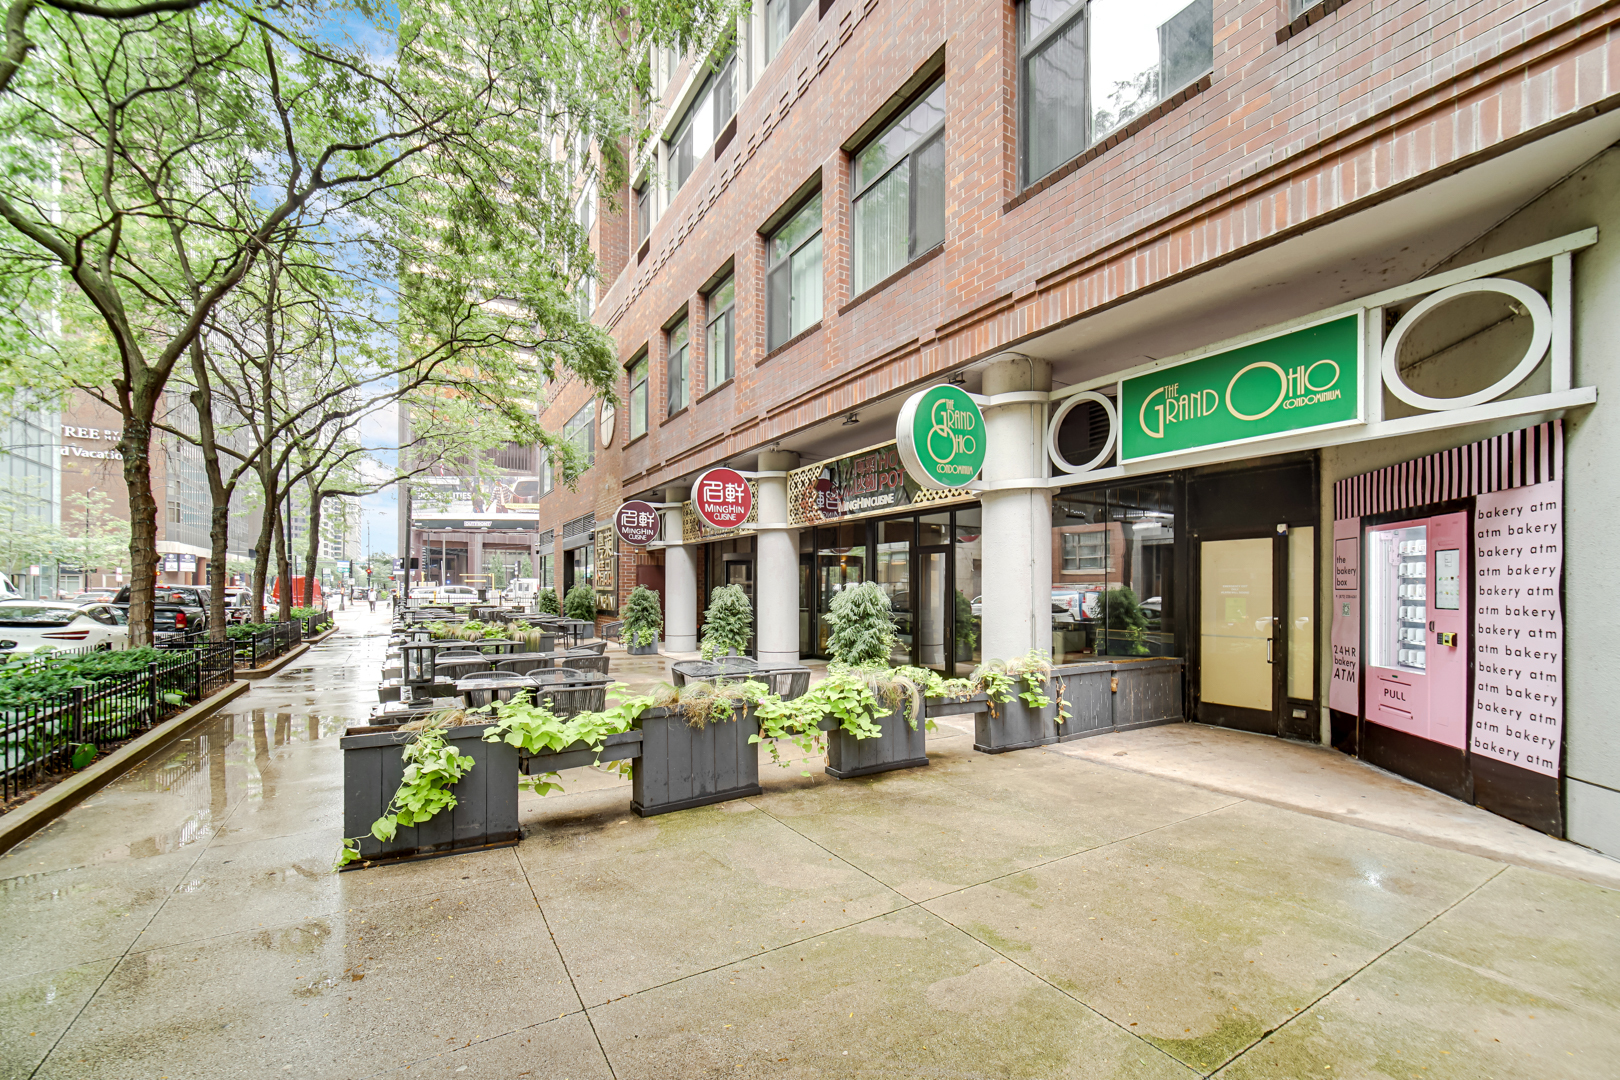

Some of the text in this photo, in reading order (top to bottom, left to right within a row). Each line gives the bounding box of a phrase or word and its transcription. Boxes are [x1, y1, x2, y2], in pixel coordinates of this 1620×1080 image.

[1139, 359, 1340, 439] GRAND OHIO
[1165, 383, 1179, 400] THE
[946, 398, 954, 410] THE
[1283, 389, 1341, 410] CONDOMINIUM
[932, 398, 975, 438] GRAND
[61, 424, 100, 439] REE
[927, 424, 976, 464] OHIO
[879, 450, 903, 471] HO
[936, 464, 974, 475] CONDOMINIUM
[880, 468, 906, 490] POT
[1478, 502, 1556, 519] bakery atm
[1478, 523, 1557, 538] atm bakery
[1478, 544, 1556, 557] bakery atm
[1336, 555, 1346, 564] the
[1336, 566, 1356, 576] bakery
[1479, 564, 1556, 577] atm bakery
[1336, 578, 1347, 586] box
[1479, 585, 1554, 598] bakery atm
[1479, 605, 1556, 620] atm bakery
[1478, 623, 1556, 639] bakery atm
[1334, 644, 1356, 657] 24HR
[1479, 645, 1557, 663] atm bakery
[1334, 655, 1356, 670] bakery
[1334, 668, 1355, 683] ATM
[1479, 661, 1556, 682] bakery atm
[1384, 688, 1406, 701] PULL
[1478, 683, 1557, 706] atm bakery
[1477, 699, 1556, 726] bakery atm
[1476, 721, 1555, 749] atm bakery
[1474, 737, 1553, 769] bakery atm
